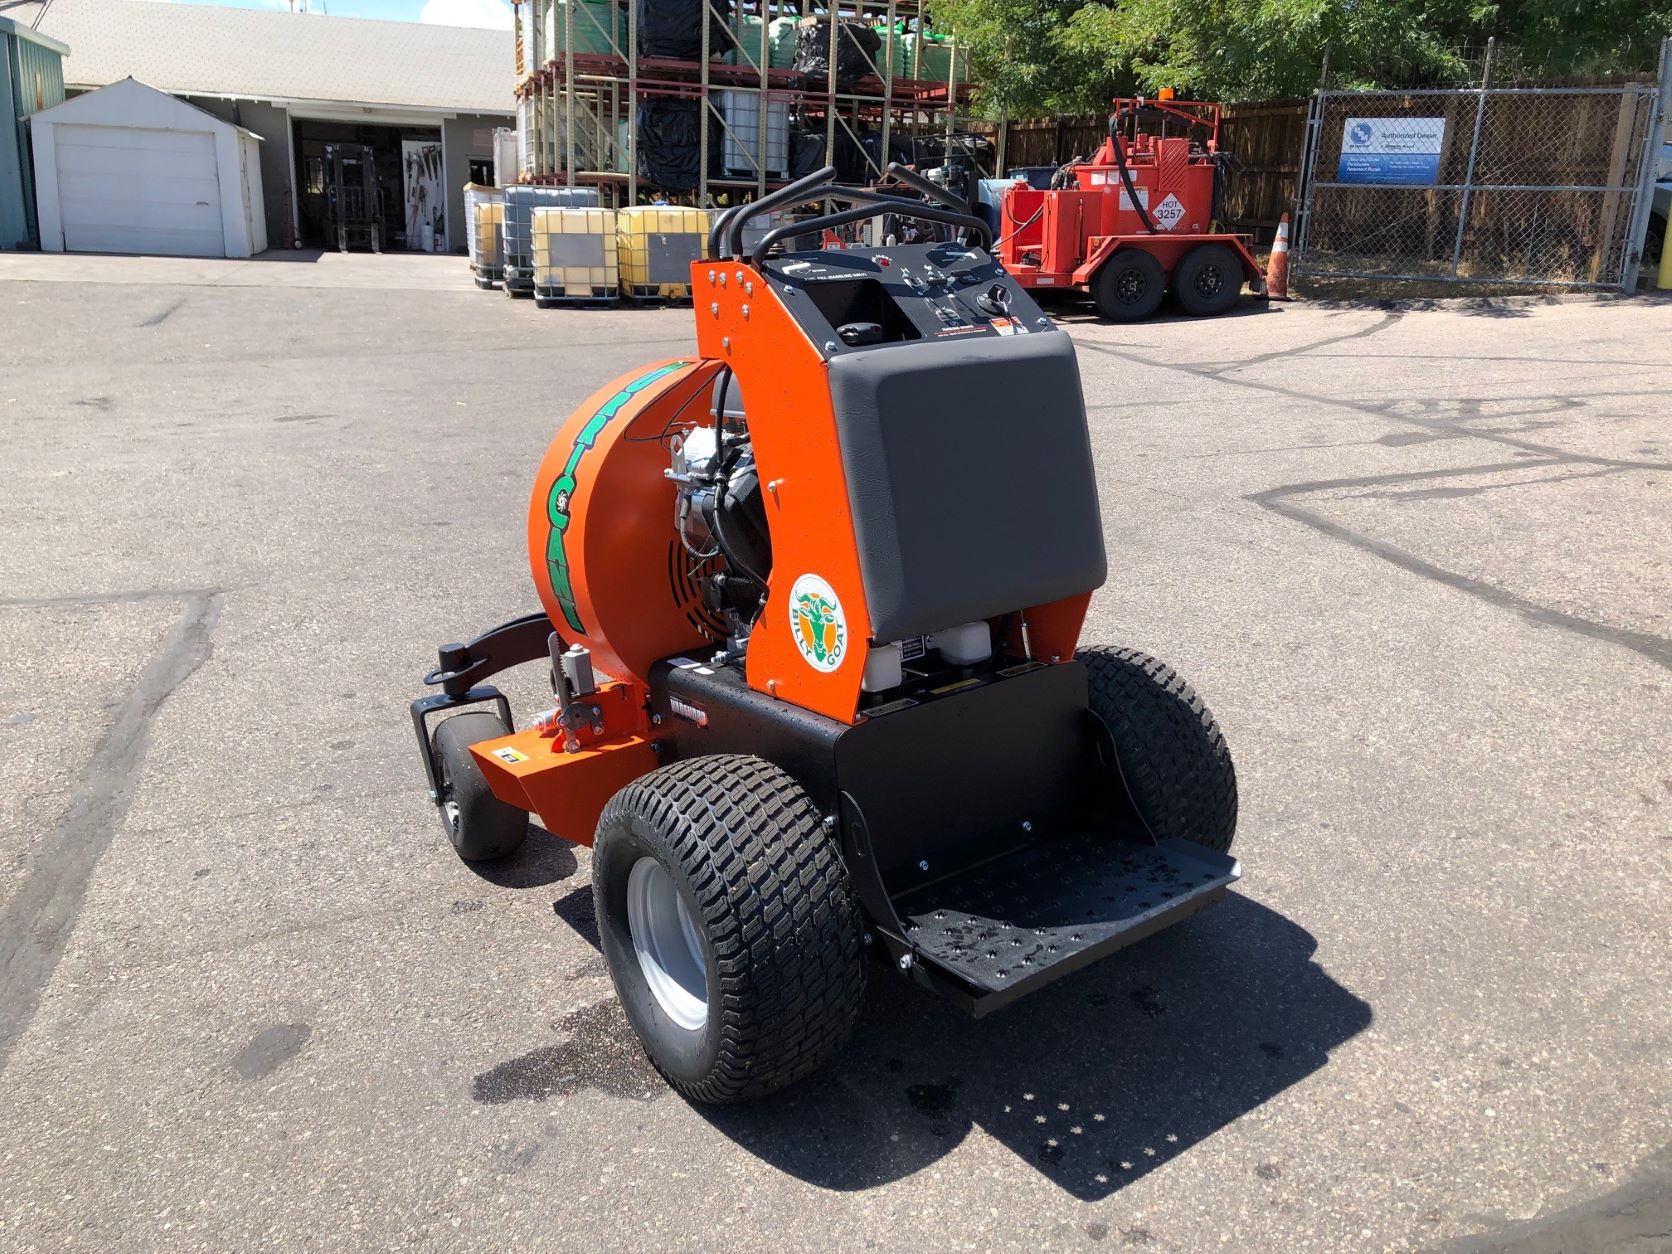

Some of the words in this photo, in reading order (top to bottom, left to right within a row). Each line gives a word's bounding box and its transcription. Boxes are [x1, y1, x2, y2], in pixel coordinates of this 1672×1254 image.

[1157, 209, 1182, 219] 3257
[792, 608, 812, 657] BILLY
[827, 623, 844, 666] GOAT
